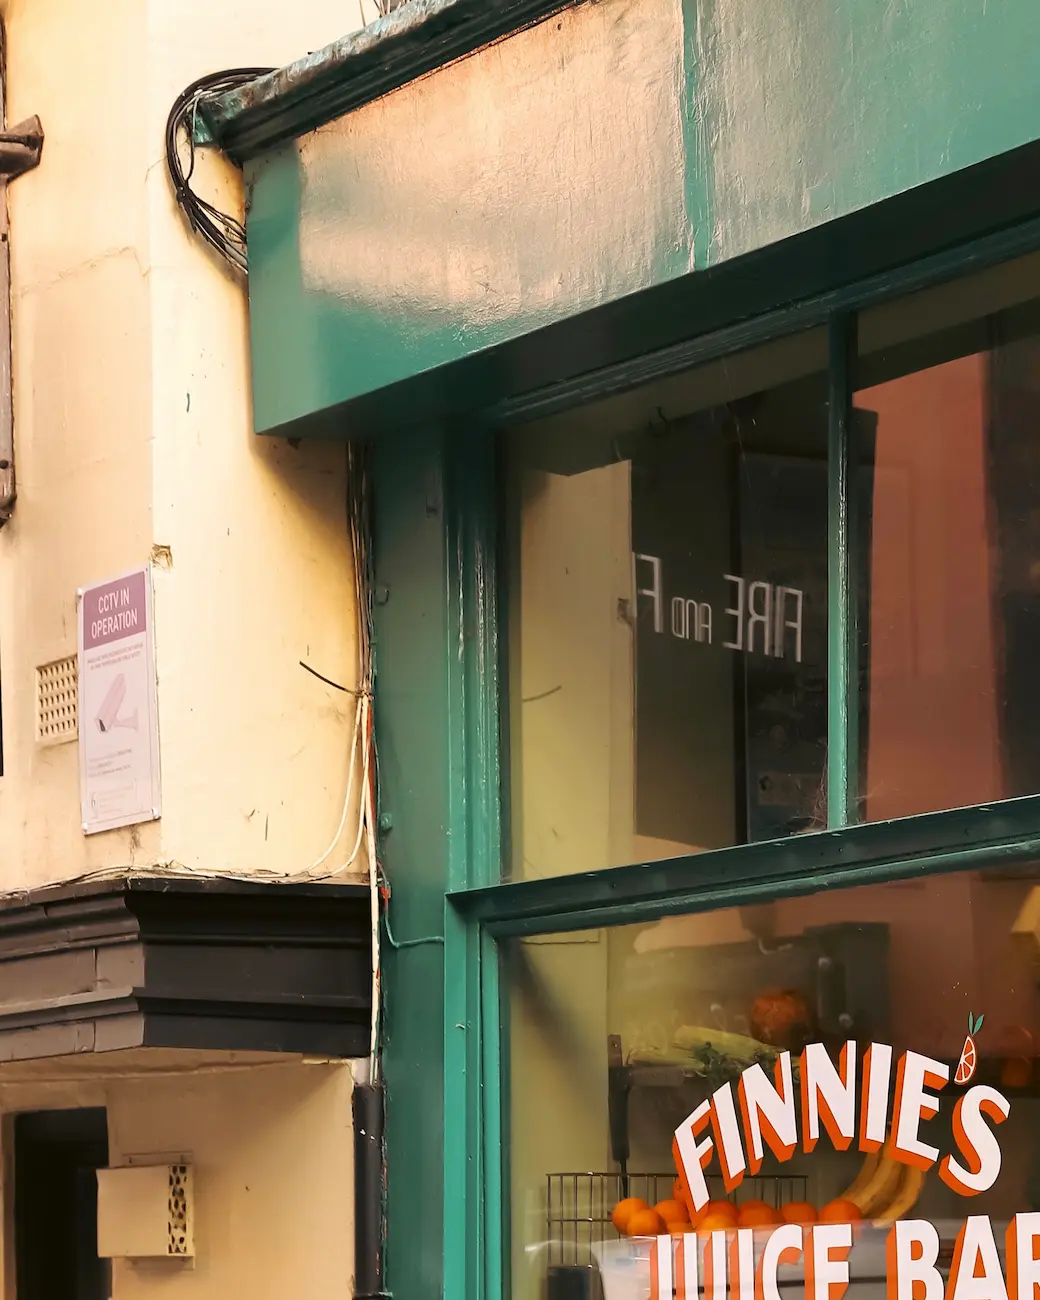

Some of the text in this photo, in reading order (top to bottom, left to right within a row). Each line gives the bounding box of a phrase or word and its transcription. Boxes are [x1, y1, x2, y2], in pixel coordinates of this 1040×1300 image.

[98, 587, 130, 614] CCTV IN
[91, 608, 138, 640] OPERATION
